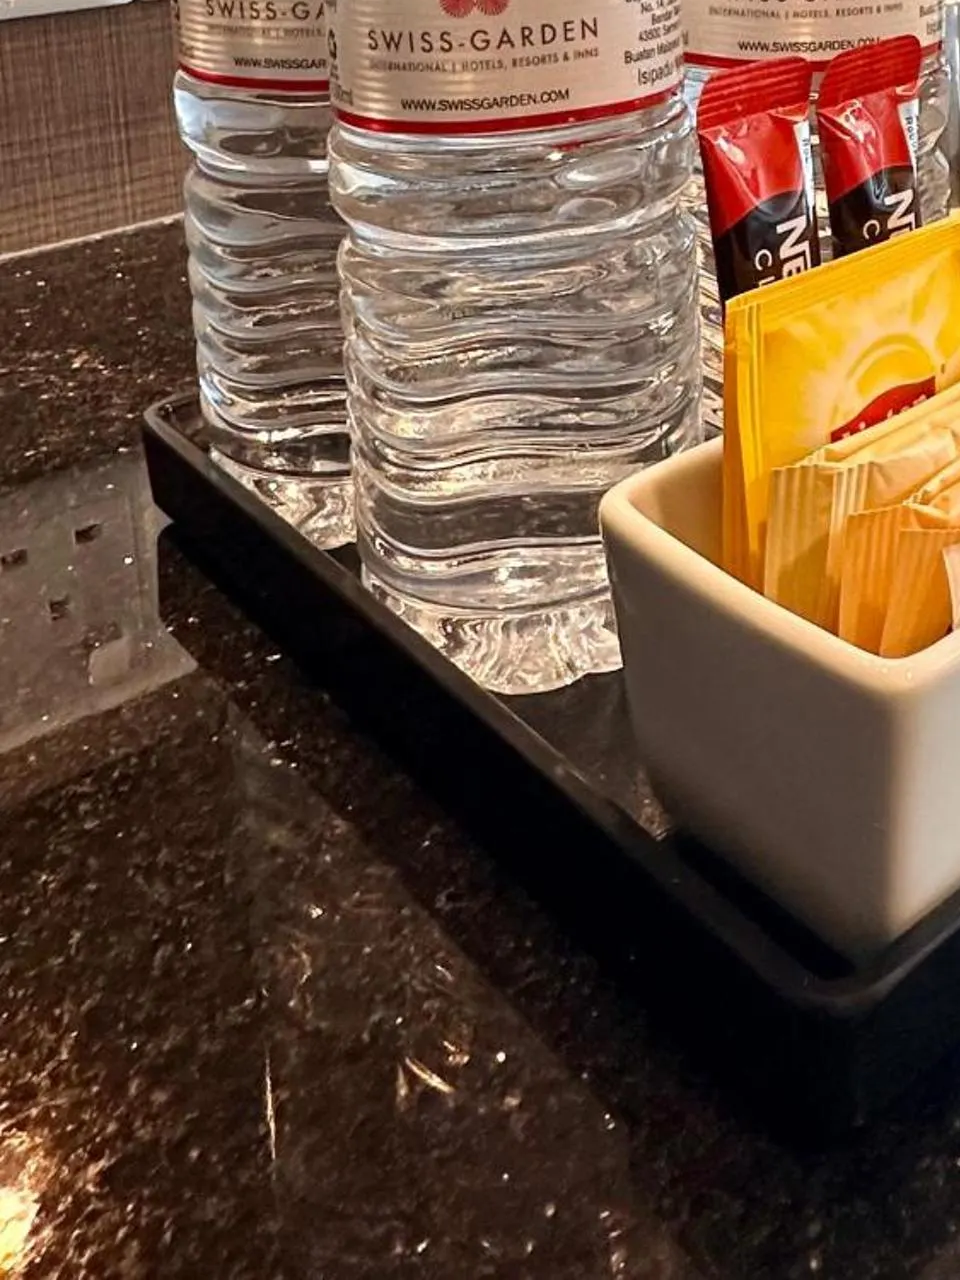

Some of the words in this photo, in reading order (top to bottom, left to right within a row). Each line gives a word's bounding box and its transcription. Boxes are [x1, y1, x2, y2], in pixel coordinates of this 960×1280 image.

[835, 5, 874, 17] RESORTS
[367, 17, 599, 53] SWISS-GARDEN
[369, 57, 447, 74] ERNATIONAL
[511, 54, 560, 69] RESORTS
[573, 47, 600, 62] INNS
[400, 88, 570, 113] WWW.SWISSGARDEN.COM
